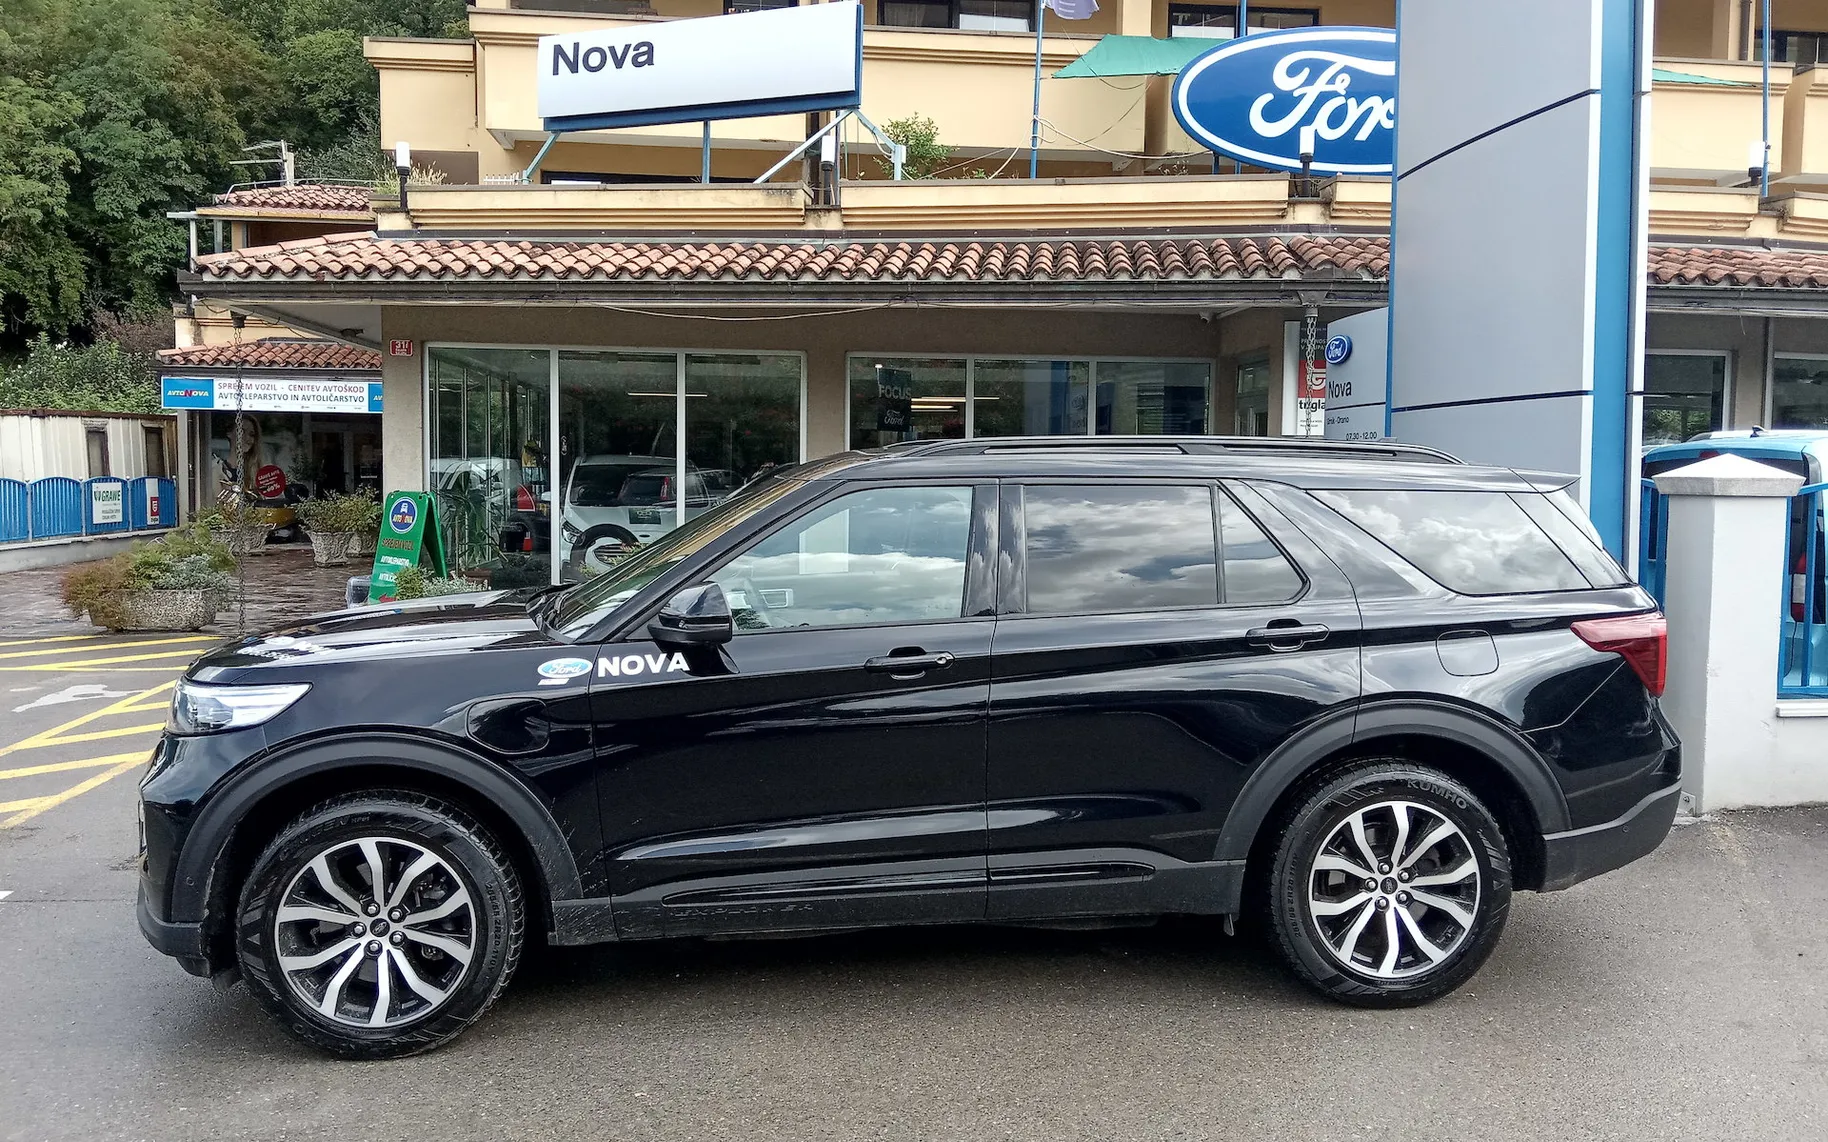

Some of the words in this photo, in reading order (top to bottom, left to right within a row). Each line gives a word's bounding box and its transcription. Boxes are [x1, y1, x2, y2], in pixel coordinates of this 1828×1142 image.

[552, 40, 655, 76] Nova
[218, 382, 253, 390] SPREEM
[254, 383, 277, 391] VOZIL
[287, 384, 321, 392] CENITEV
[322, 384, 365, 393] AVTOŠKOD
[878, 384, 912, 400] FOCUS
[1328, 381, 1352, 399] Nova
[301, 394, 365, 403] AVTOLIČARSTVO
[884, 409, 905, 426] Ford
[102, 490, 121, 502] GRAWE
[549, 662, 582, 675] Ford
[597, 652, 691, 678] NOVA
[1407, 778, 1467, 809] KUMHO
